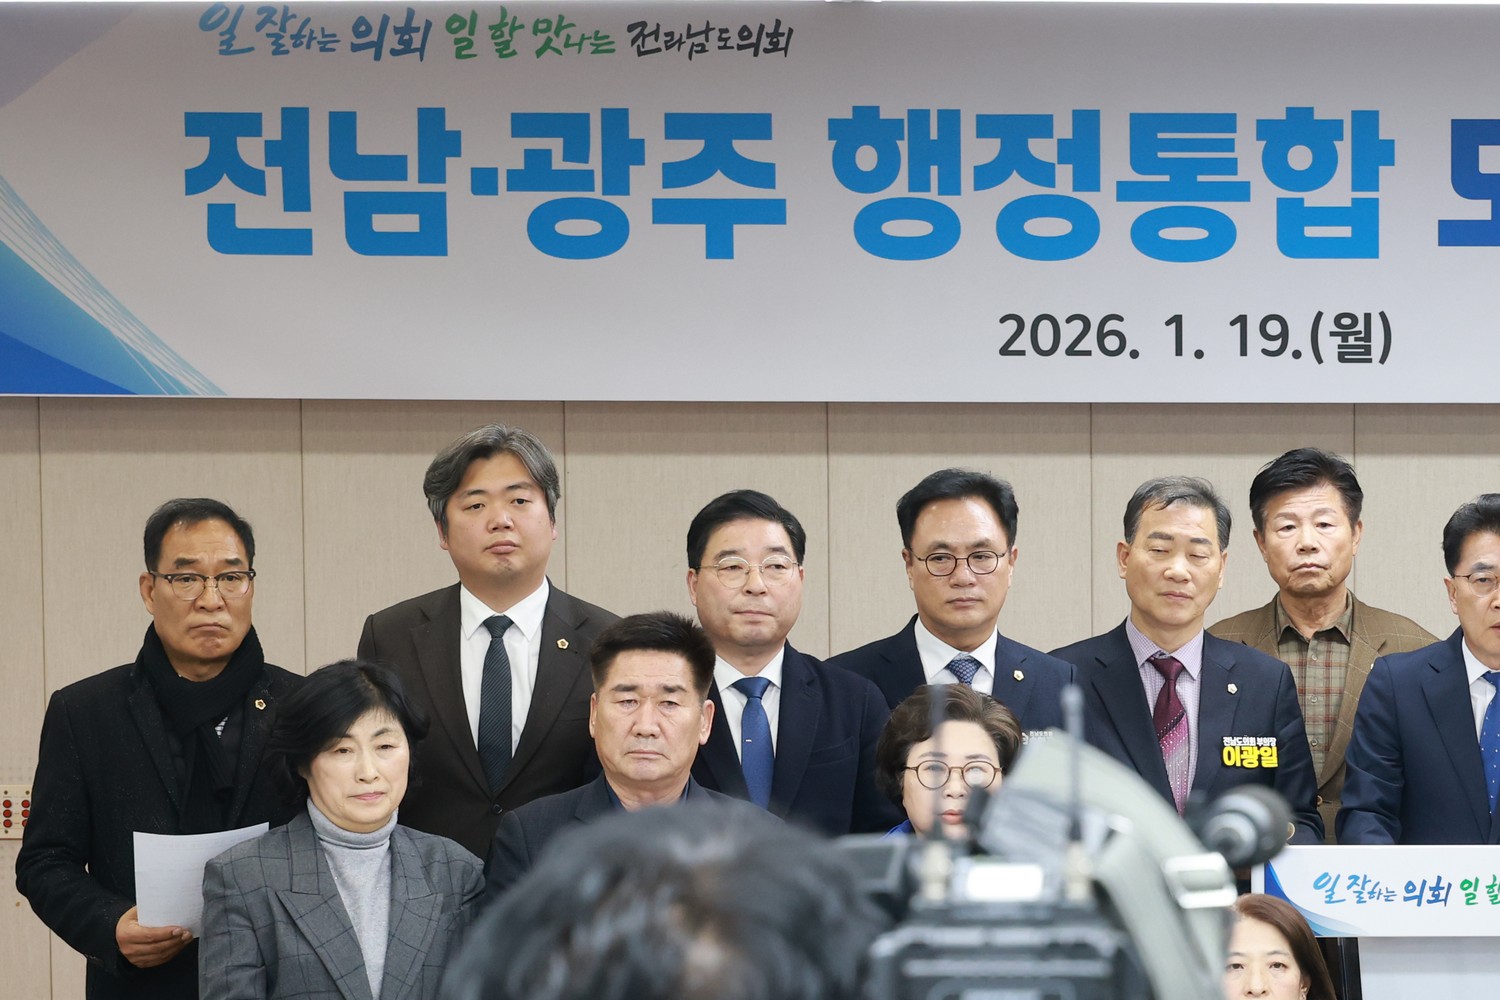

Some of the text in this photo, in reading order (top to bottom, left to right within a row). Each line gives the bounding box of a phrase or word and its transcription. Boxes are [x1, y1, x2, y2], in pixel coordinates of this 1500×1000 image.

[350, 7, 433, 62] 의회
[626, 18, 794, 61] 전라남도의회
[827, 105, 1395, 264] 행정통합
[998, 313, 1140, 360] 2026.
[1164, 313, 1205, 360] 1.
[1222, 746, 1279, 768] 이광일
[1402, 875, 1453, 908] 의회
